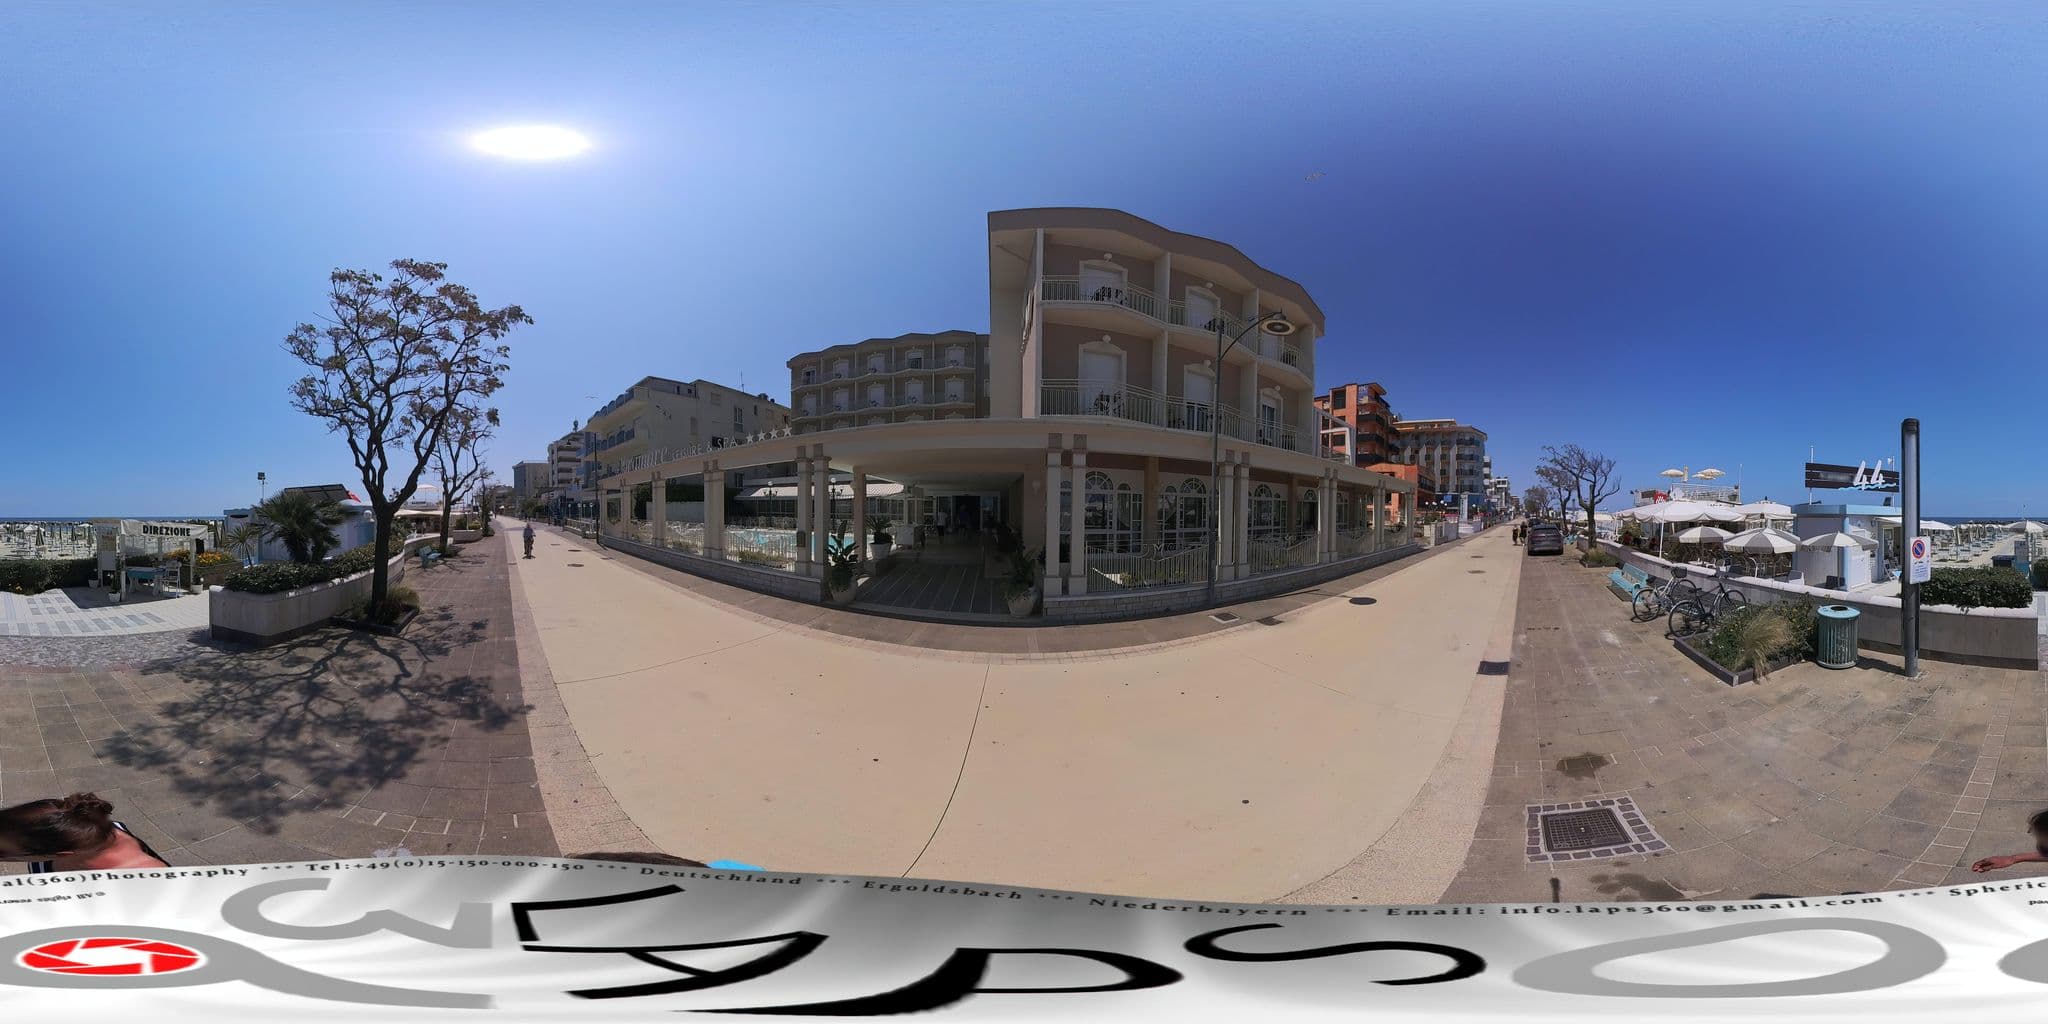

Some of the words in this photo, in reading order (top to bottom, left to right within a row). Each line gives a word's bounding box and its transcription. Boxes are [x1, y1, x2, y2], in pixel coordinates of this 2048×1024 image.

[717, 435, 738, 450] SPA
[1852, 459, 1885, 491] 44
[143, 525, 191, 536] DIREZIONE
